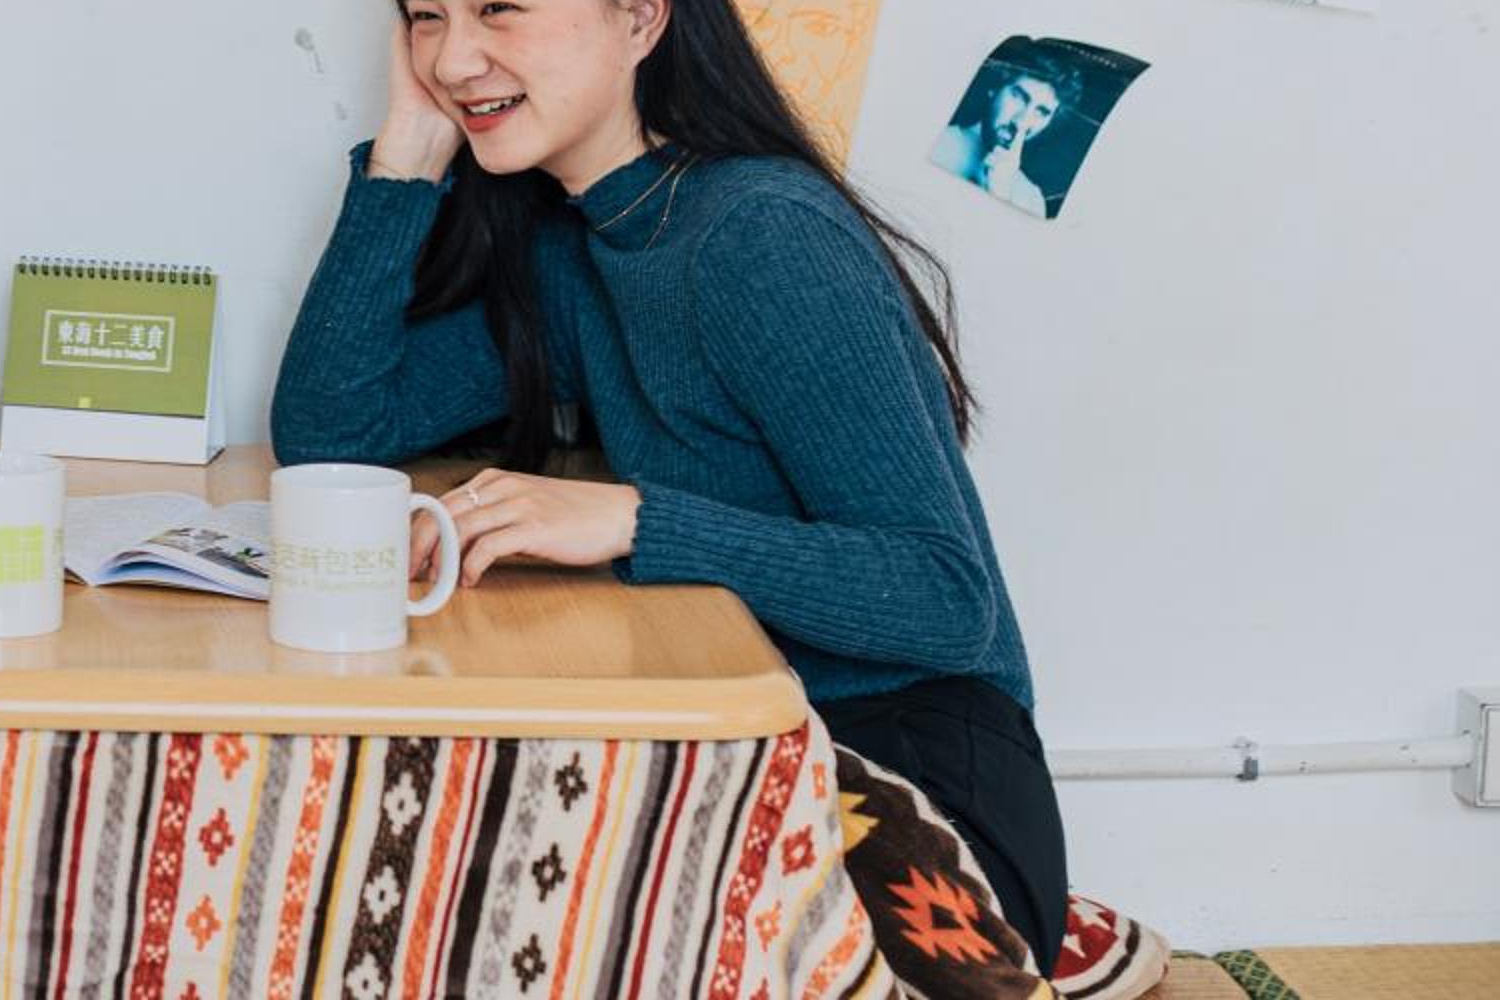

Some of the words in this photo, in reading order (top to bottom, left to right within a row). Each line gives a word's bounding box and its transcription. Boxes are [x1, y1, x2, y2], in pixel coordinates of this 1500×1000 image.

[59, 320, 164, 349] 東海十二美食
